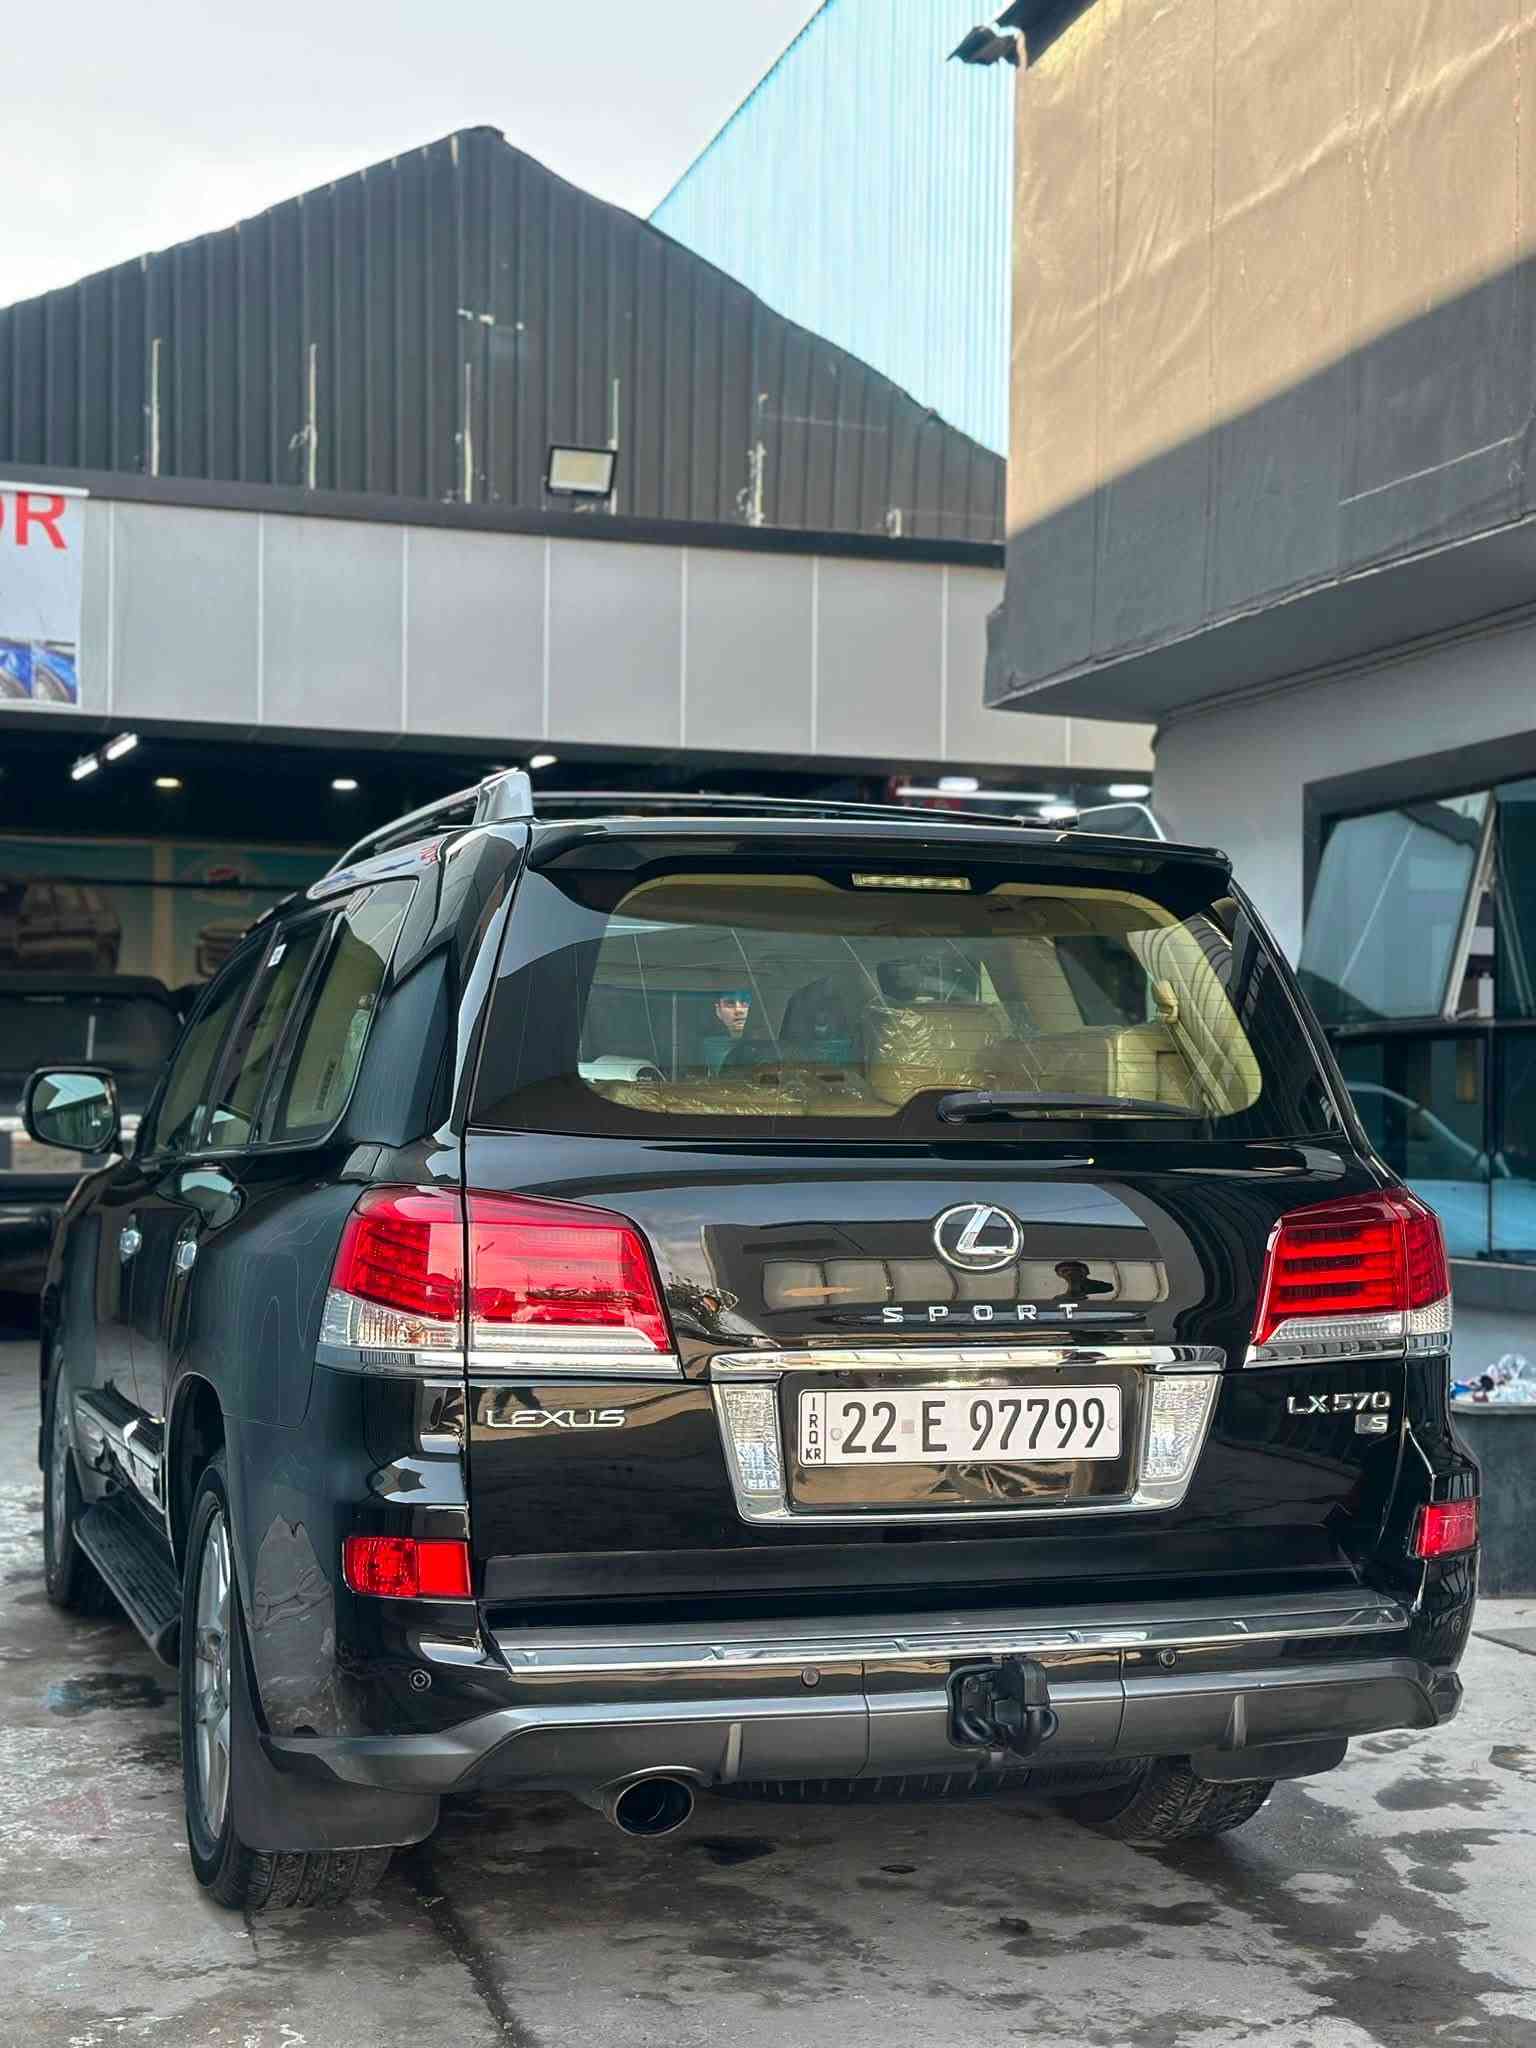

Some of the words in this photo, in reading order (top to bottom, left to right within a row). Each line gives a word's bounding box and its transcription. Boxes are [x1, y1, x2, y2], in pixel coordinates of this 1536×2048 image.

[0, 491, 67, 550] R
[882, 1303, 1078, 1323] SPORT
[1287, 1391, 1391, 1414] LX570
[485, 1408, 626, 1428] LEXUS
[841, 1401, 897, 1454] 22
[921, 1400, 948, 1452] E
[969, 1398, 1105, 1451] 97799
[805, 1447, 822, 1460] KR
